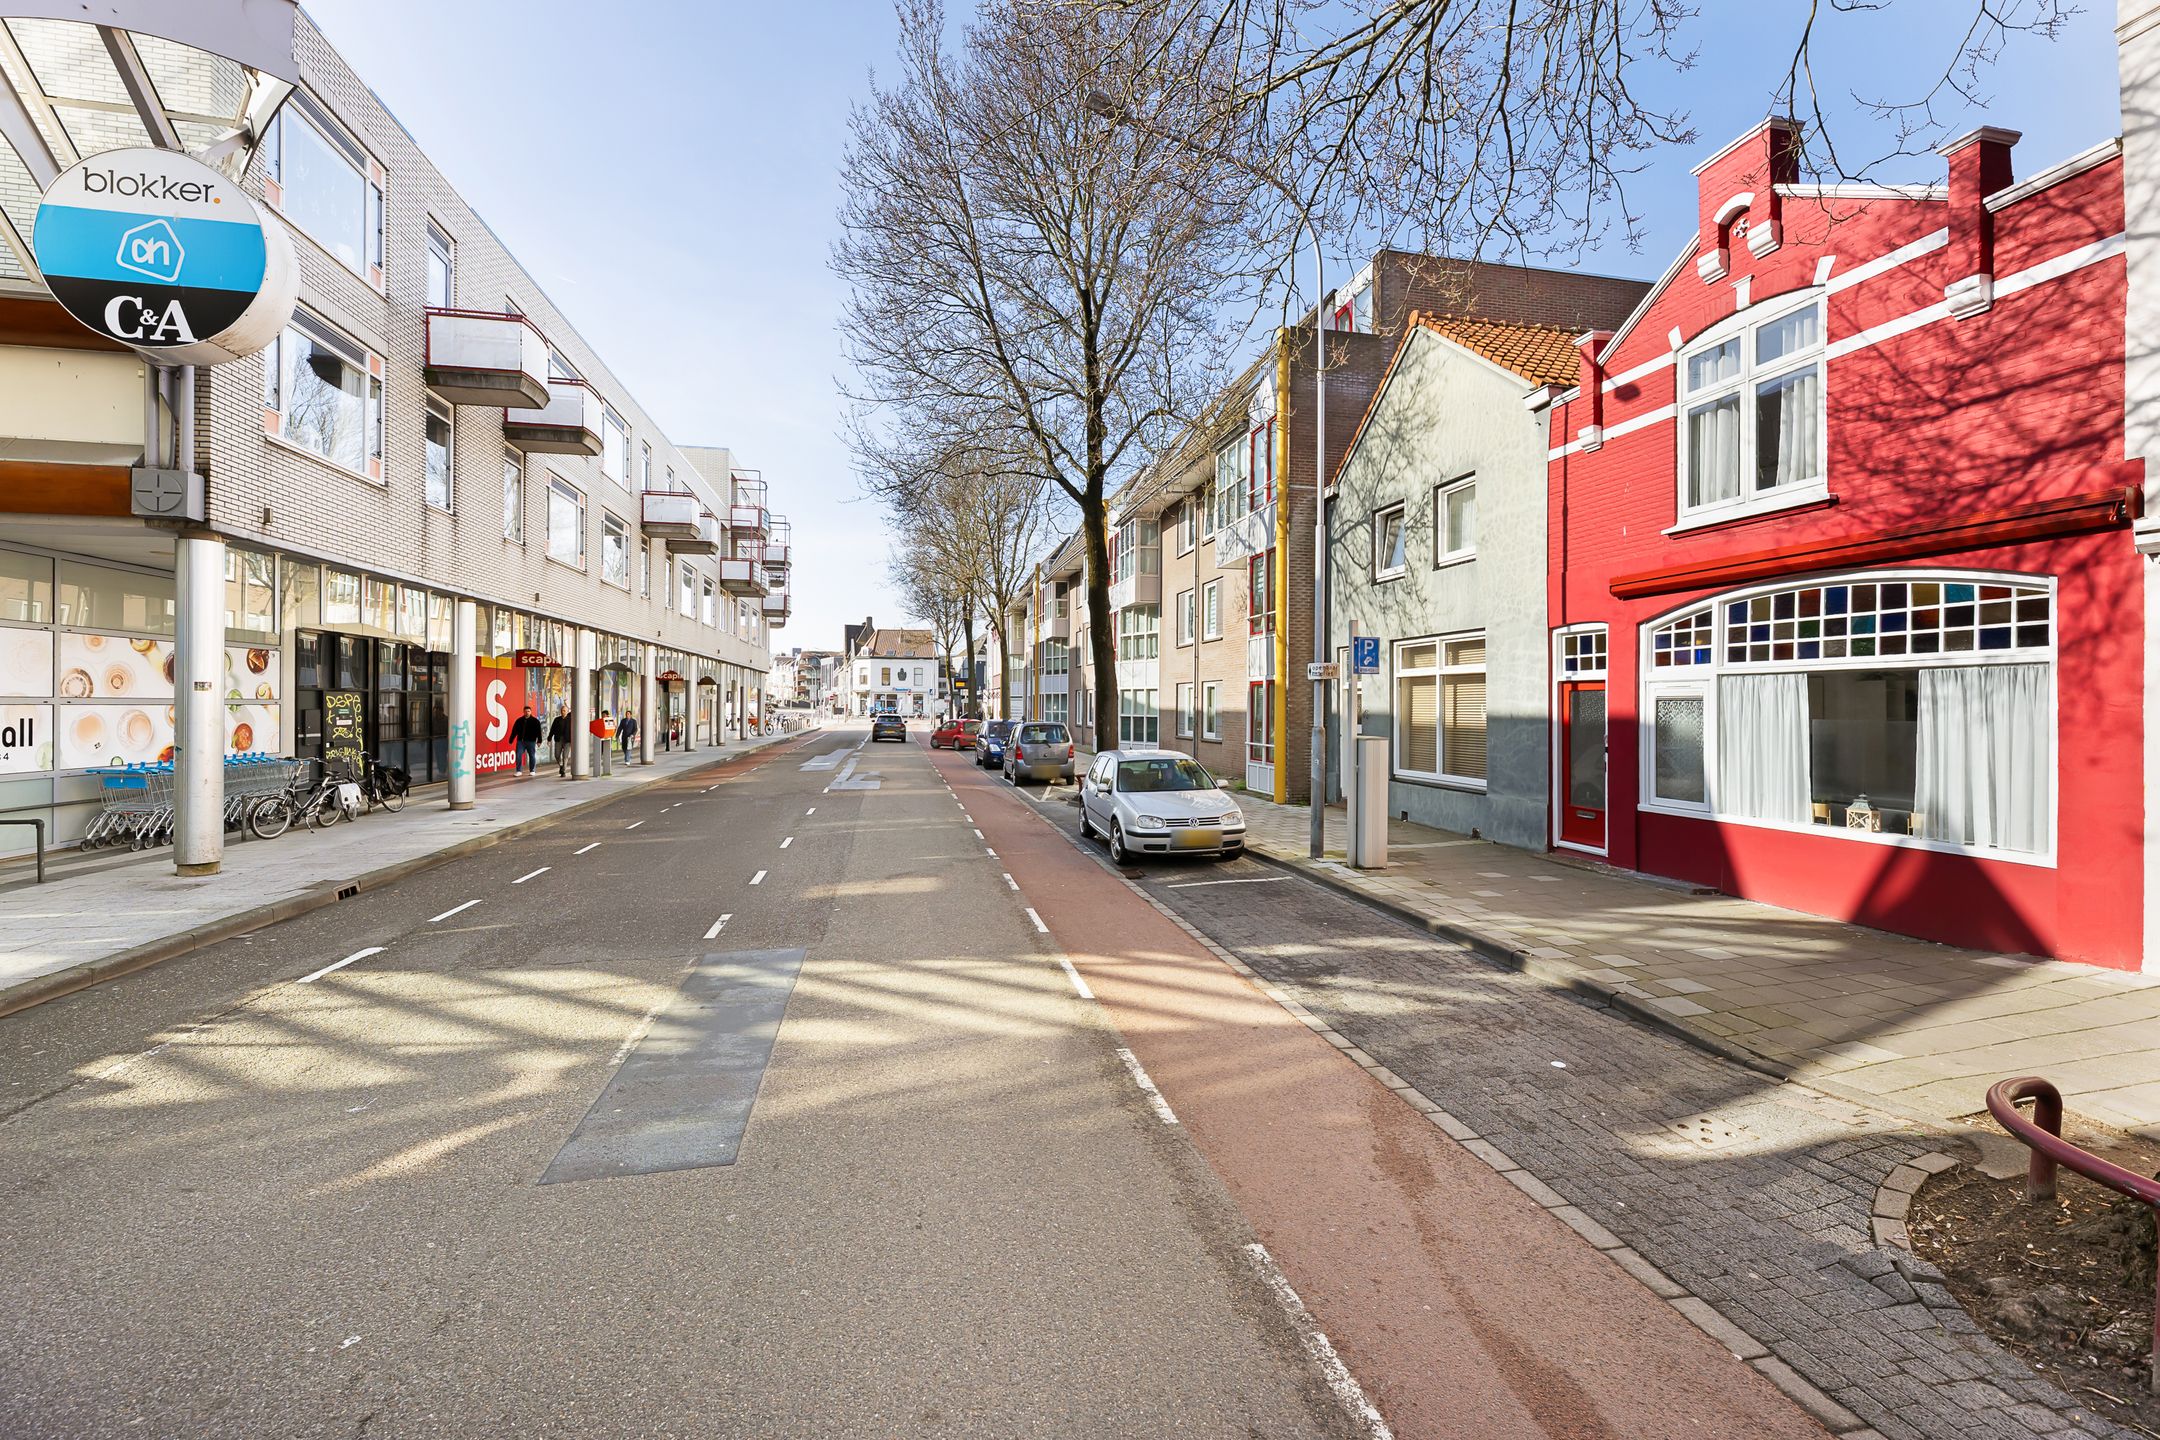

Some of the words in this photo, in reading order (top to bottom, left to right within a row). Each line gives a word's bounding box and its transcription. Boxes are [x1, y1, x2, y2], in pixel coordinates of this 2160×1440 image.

[104, 295, 198, 343] C&A
[1363, 639, 1374, 655] P
[521, 655, 560, 667] scapi
[485, 679, 509, 742] S
[476, 750, 516, 772] scapino
